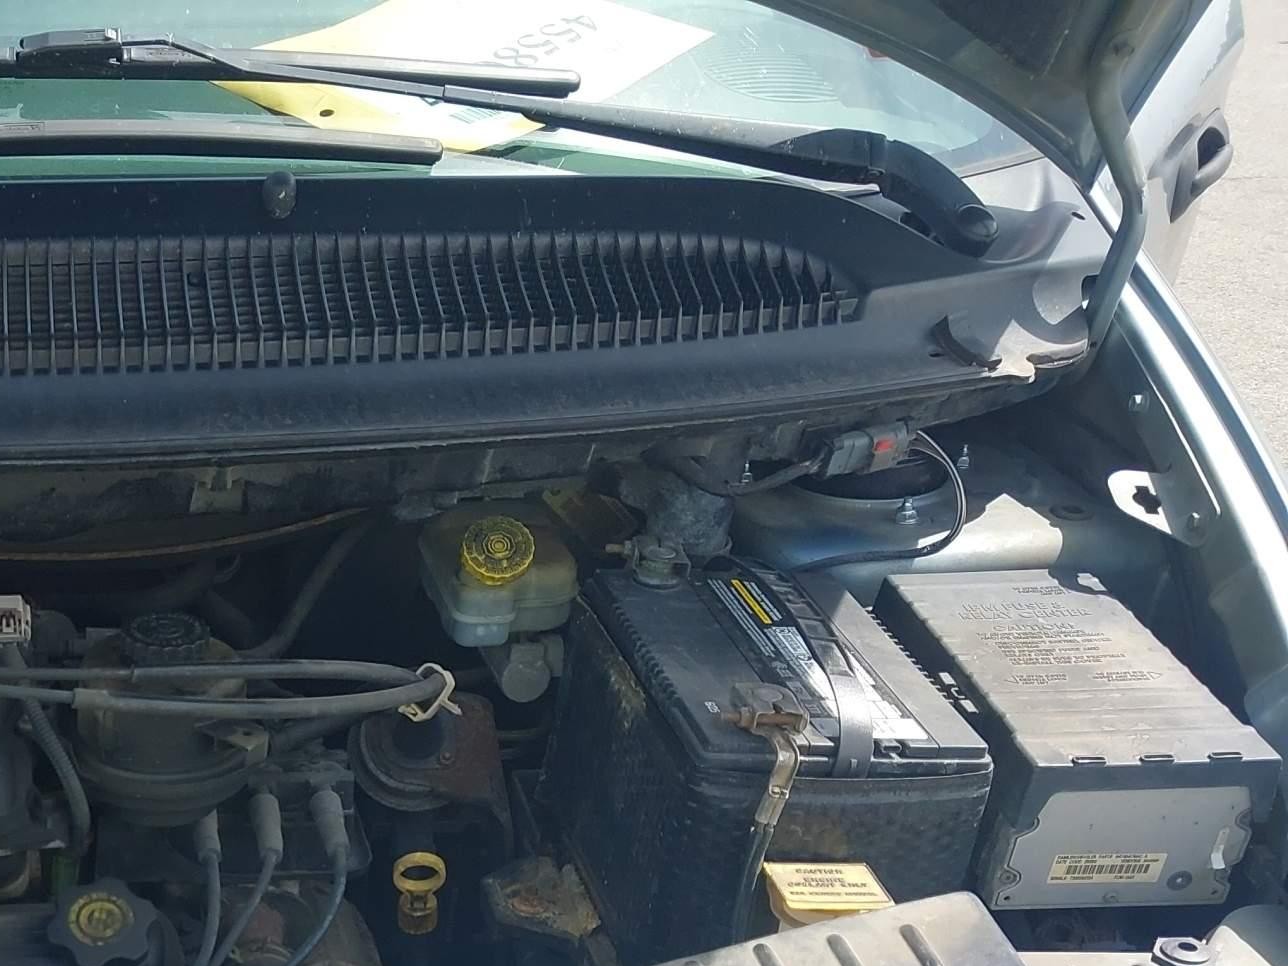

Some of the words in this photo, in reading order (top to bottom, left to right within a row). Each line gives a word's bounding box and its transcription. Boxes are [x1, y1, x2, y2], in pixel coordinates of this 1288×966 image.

[474, 15, 598, 68] 4558
[1001, 602, 1048, 611] FUSE
[958, 611, 1013, 620] RELAY
[1018, 608, 1094, 619] CENTER
